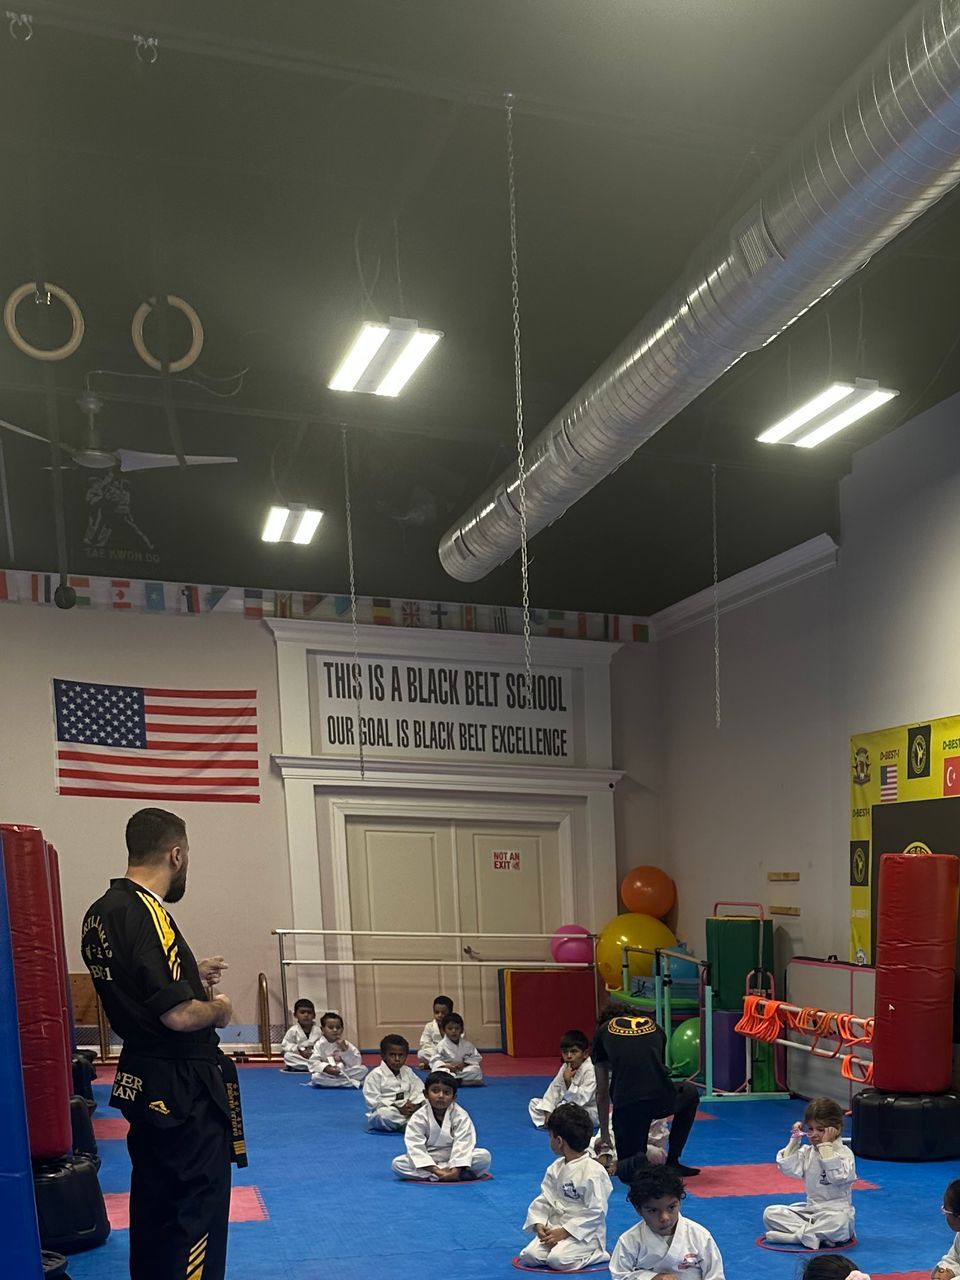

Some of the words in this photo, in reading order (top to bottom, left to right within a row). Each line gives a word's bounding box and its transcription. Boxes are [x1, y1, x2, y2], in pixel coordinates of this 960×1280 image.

[84, 547, 105, 558] TAE
[323, 661, 363, 700] THIS
[368, 664, 385, 702] IS
[391, 666, 403, 702] A
[406, 666, 461, 705] BLACK
[464, 670, 500, 708] BELT
[506, 672, 567, 712] SCHOOL
[327, 715, 355, 745] OUR
[359, 716, 393, 748] GOAL
[396, 718, 410, 748] IS
[413, 720, 456, 751] BLACK
[459, 722, 488, 752] BELT
[491, 724, 568, 757] EXCELLENCE
[493, 851, 508, 861] NOT
[510, 852, 520, 861] AN
[494, 860, 511, 870] EXIT
